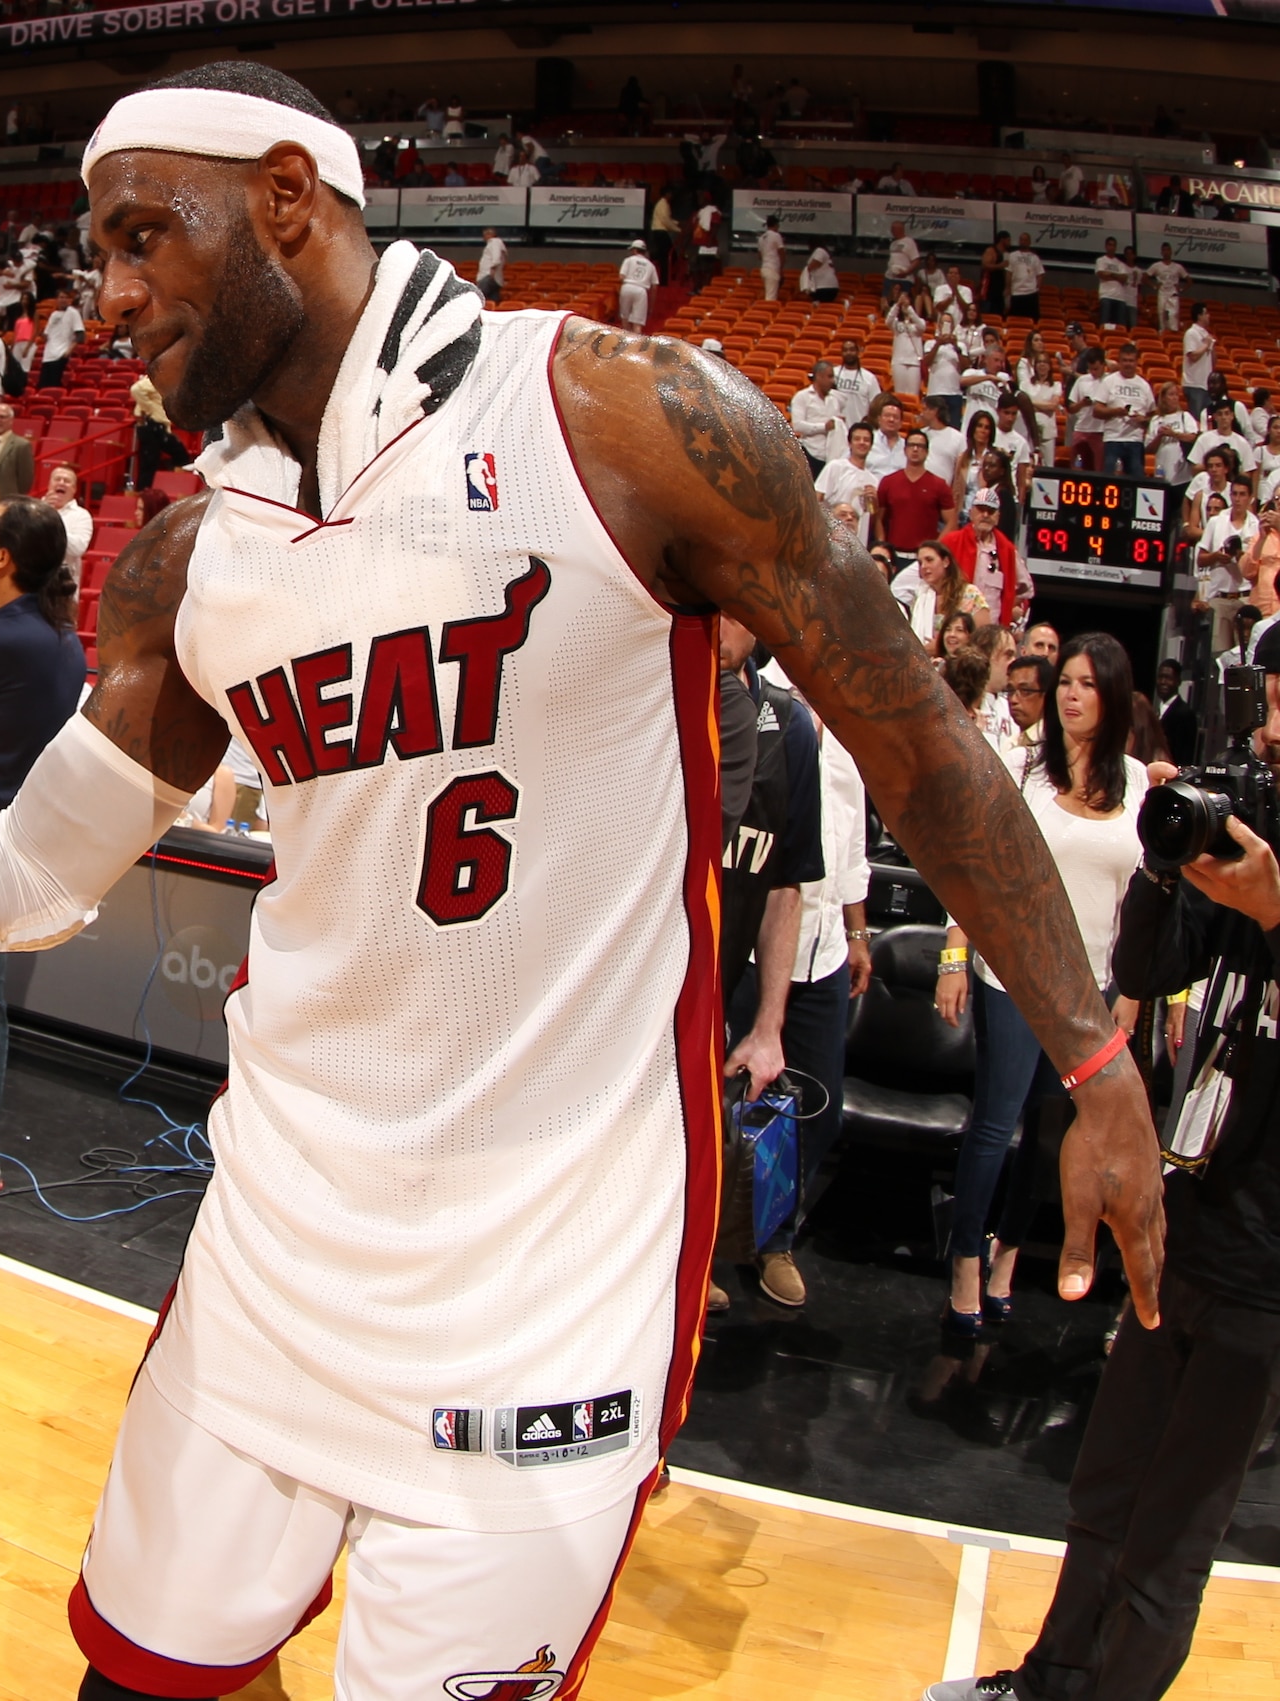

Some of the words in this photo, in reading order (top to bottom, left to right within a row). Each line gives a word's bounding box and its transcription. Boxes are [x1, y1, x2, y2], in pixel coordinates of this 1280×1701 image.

[11, 15, 94, 46] DRIVE
[103, 3, 204, 34] SOBER
[215, 1, 261, 22] OR
[434, 203, 484, 222] Arena
[557, 204, 609, 222] Arena
[1035, 223, 1090, 243] Arena
[1174, 235, 1227, 256] Arena
[1115, 385, 1141, 398] 305
[470, 498, 490, 509] NBA
[1062, 481, 1118, 509] 00.0
[1036, 511, 1056, 521] HEAT
[1131, 520, 1162, 532] PACERS
[1037, 528, 1068, 552] 99
[1089, 536, 1102, 556] 4
[1134, 539, 1165, 562] 87
[1059, 565, 1092, 578] American
[1092, 568, 1120, 580] Airlines
[226, 556, 551, 787] HEAT
[1205, 766, 1227, 775] Nikon
[412, 765, 524, 932] 6
[161, 945, 239, 993] abc
[600, 1406, 625, 1423] 2XL
[633, 1410, 641, 1438] LENGTH
[521, 1429, 562, 1441] adidas
